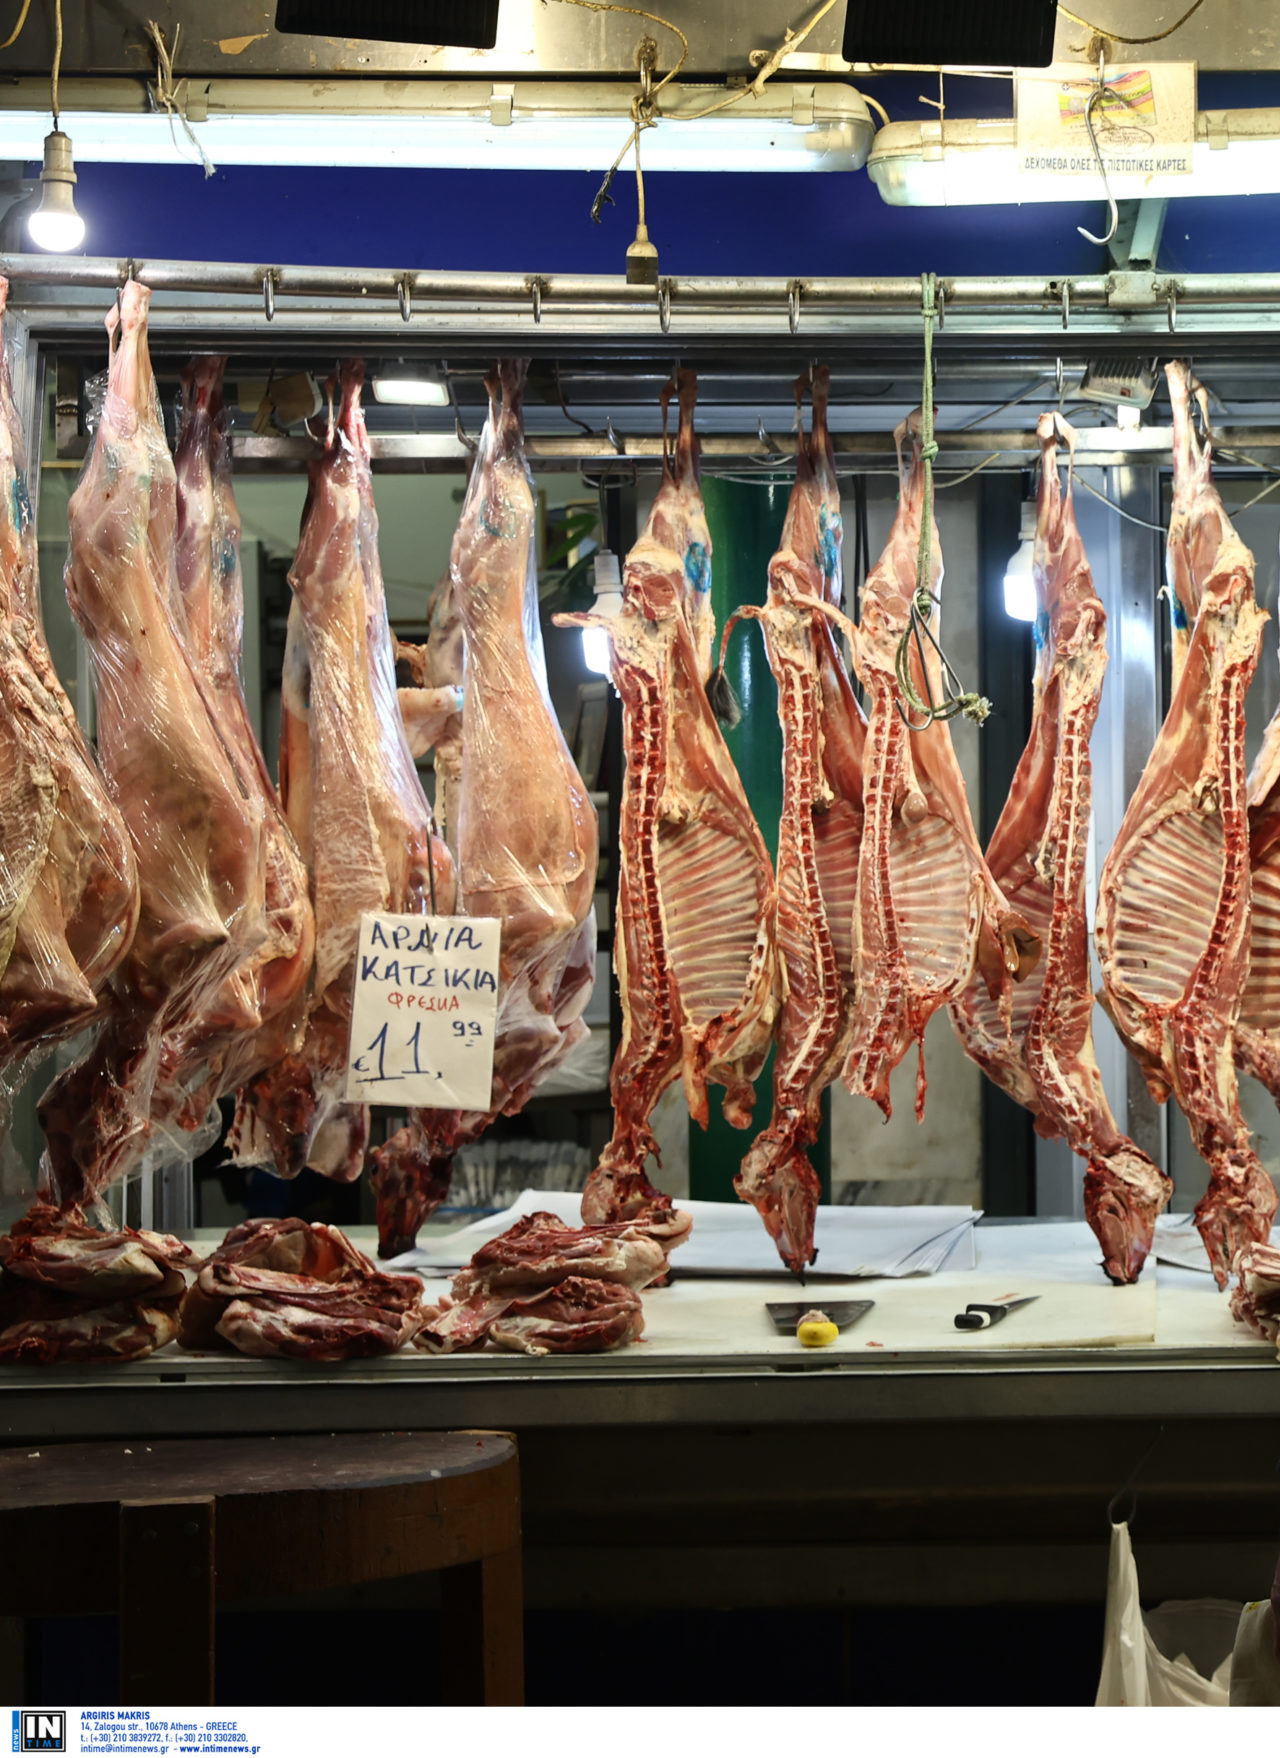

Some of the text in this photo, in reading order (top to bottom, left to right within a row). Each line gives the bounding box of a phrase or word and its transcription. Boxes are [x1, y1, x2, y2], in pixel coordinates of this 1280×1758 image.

[1025, 157, 1068, 169] ΔΕΧΟΜΕΘΑ
[1070, 158, 1091, 170] ΟΛΕΣ
[1093, 158, 1105, 170] ΤΣ
[1156, 159, 1187, 171] ΚΑΡΤΕΣ
[371, 921, 482, 951] ΑΡΝΙΑ
[361, 955, 497, 993] ΚΑΤΣΙΚΙΑ
